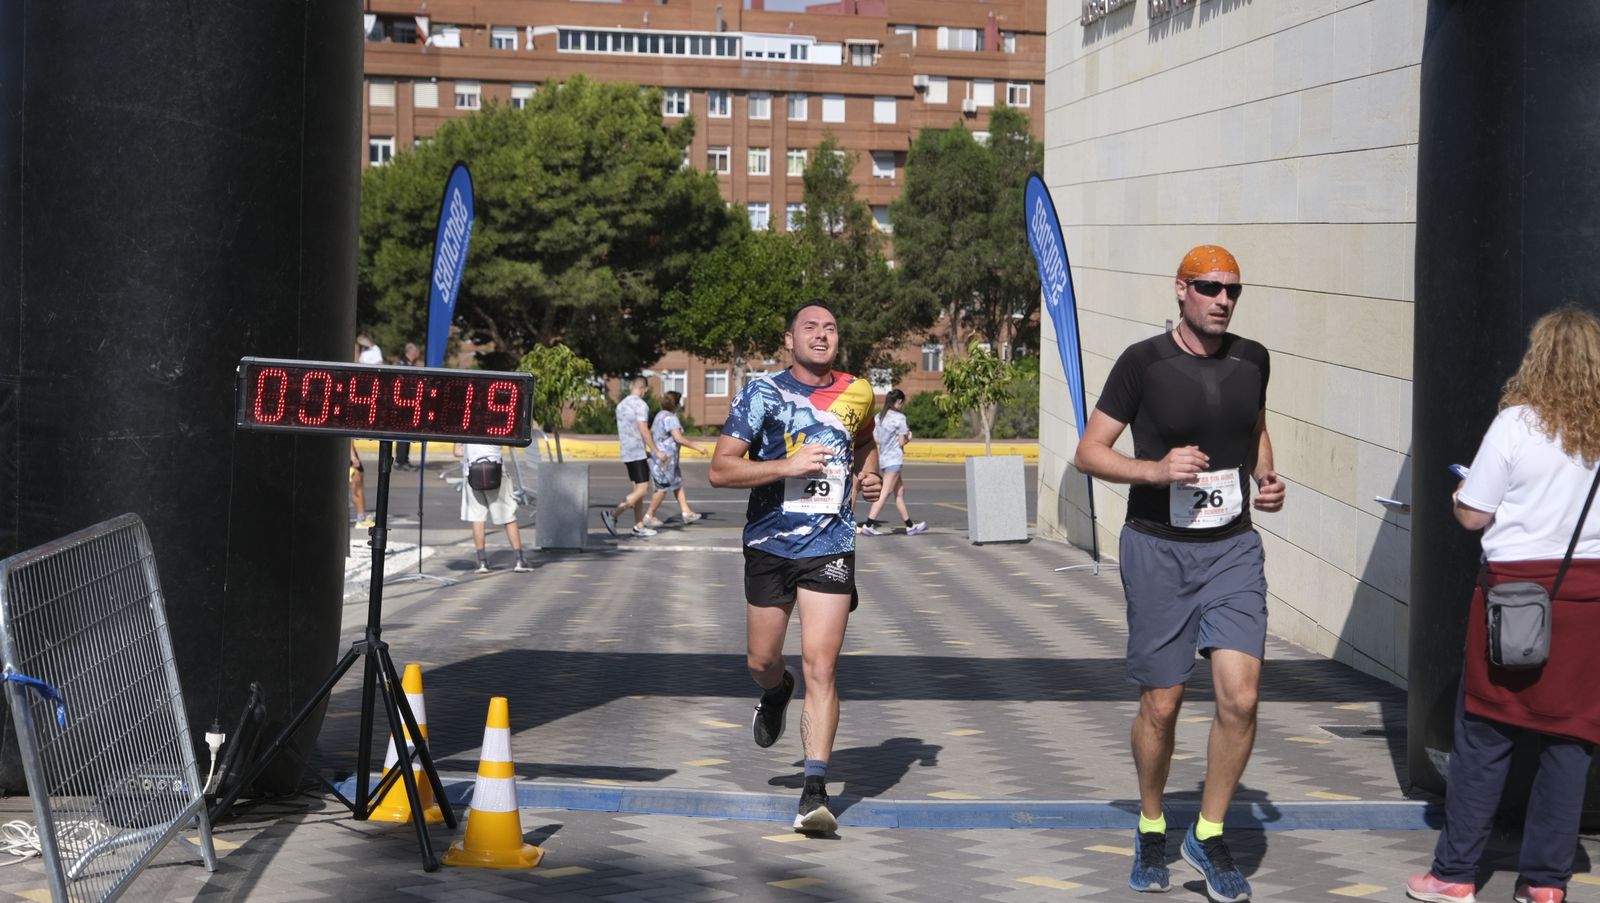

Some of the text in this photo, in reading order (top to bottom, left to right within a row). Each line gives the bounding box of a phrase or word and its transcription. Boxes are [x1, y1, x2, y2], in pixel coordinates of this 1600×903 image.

[254, 368, 518, 435] 00:44:19
[804, 480, 831, 497] 49
[1193, 489, 1223, 509] 26
